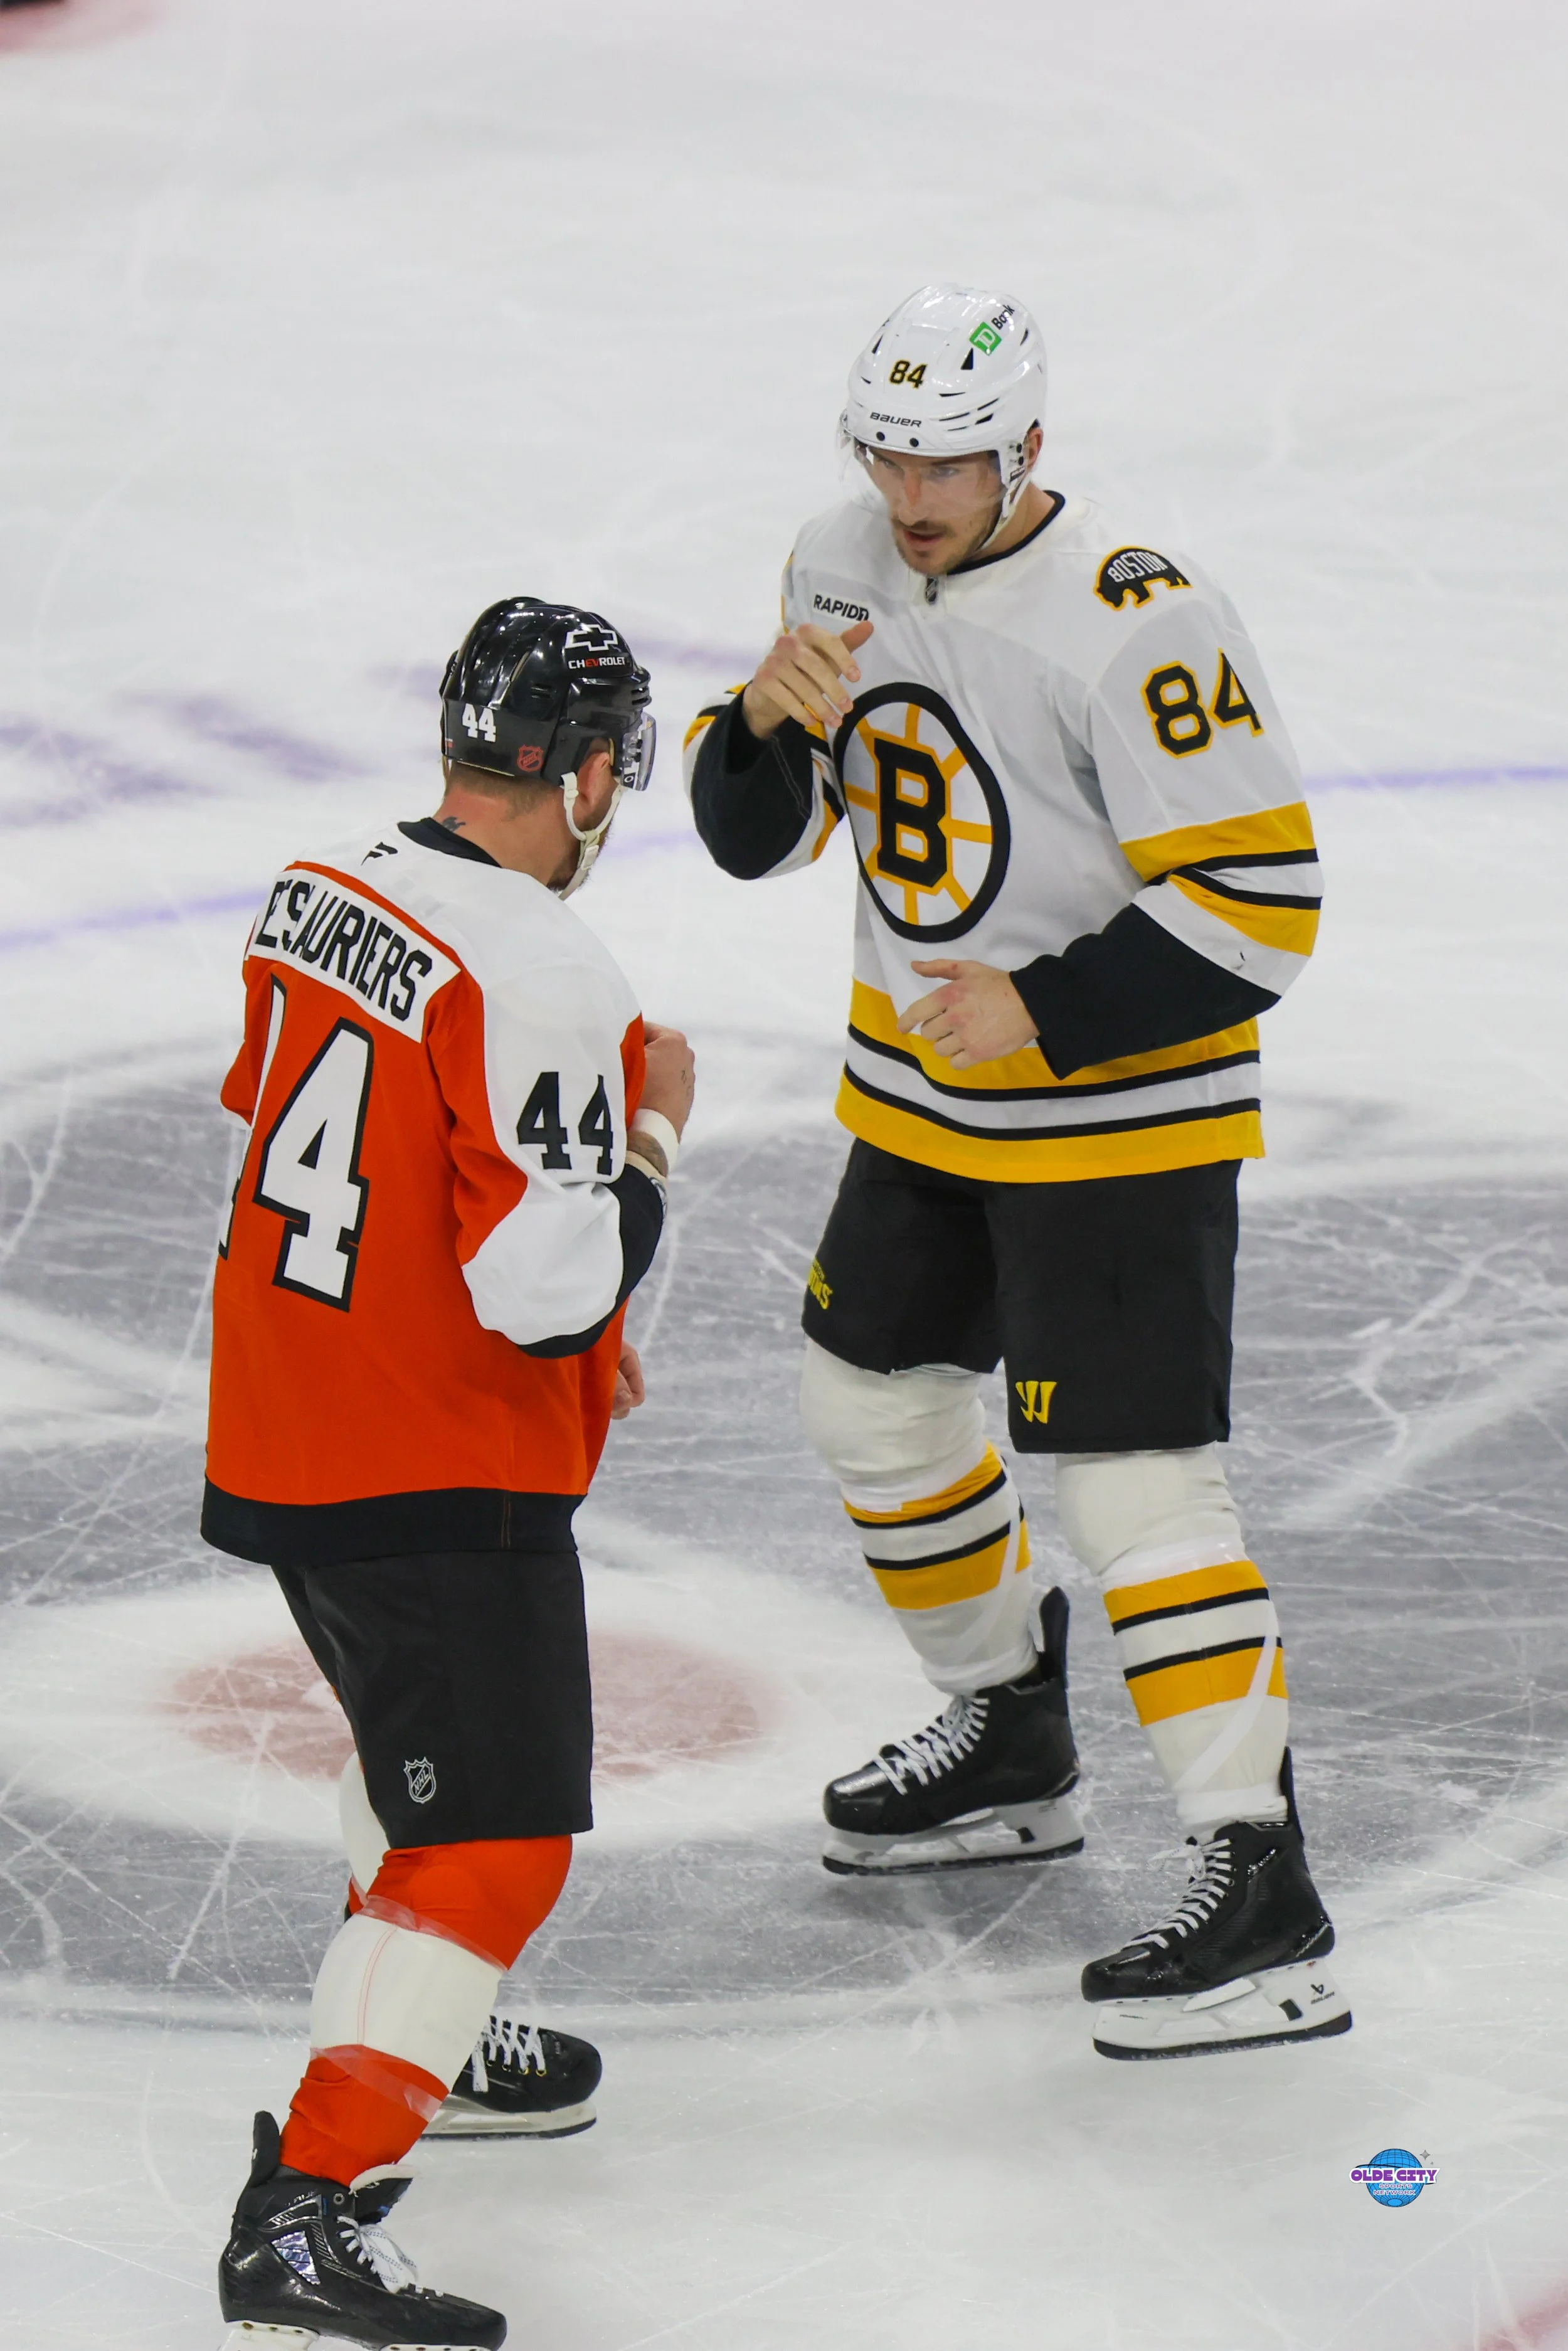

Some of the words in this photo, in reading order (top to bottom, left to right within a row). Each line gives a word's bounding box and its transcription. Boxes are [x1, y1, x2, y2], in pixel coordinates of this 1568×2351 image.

[889, 359, 928, 389] 84
[1107, 551, 1168, 583] BOSTON
[568, 656, 625, 669] CHEVROLET
[1140, 647, 1264, 760] 84
[462, 703, 497, 743] 44
[516, 1071, 614, 1176] 44
